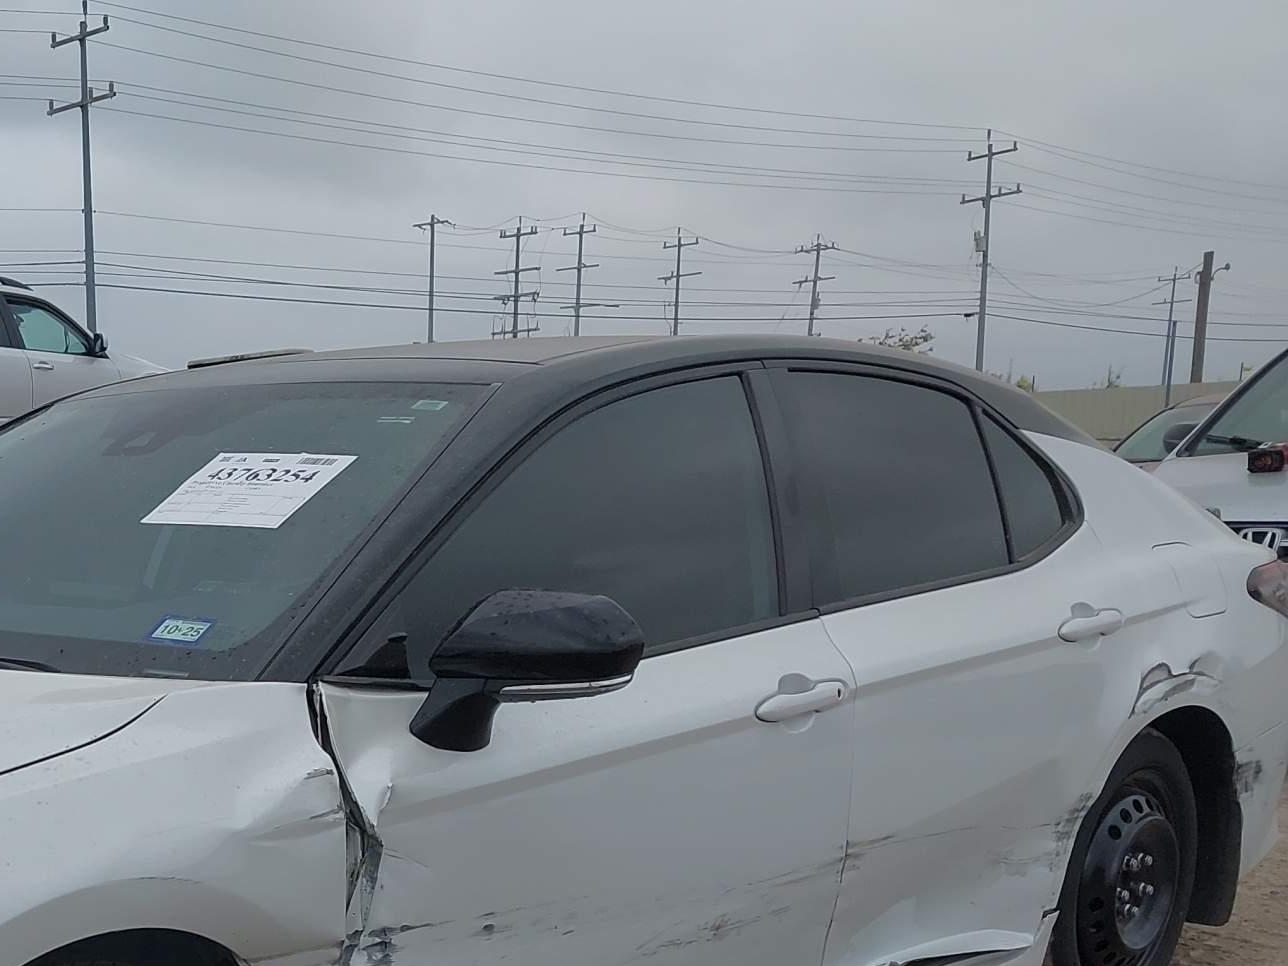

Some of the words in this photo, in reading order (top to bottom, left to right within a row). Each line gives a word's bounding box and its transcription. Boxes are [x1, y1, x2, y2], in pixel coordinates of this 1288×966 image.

[207, 467, 320, 483] 43763254
[160, 624, 179, 635] 10
[181, 626, 204, 637] 25
